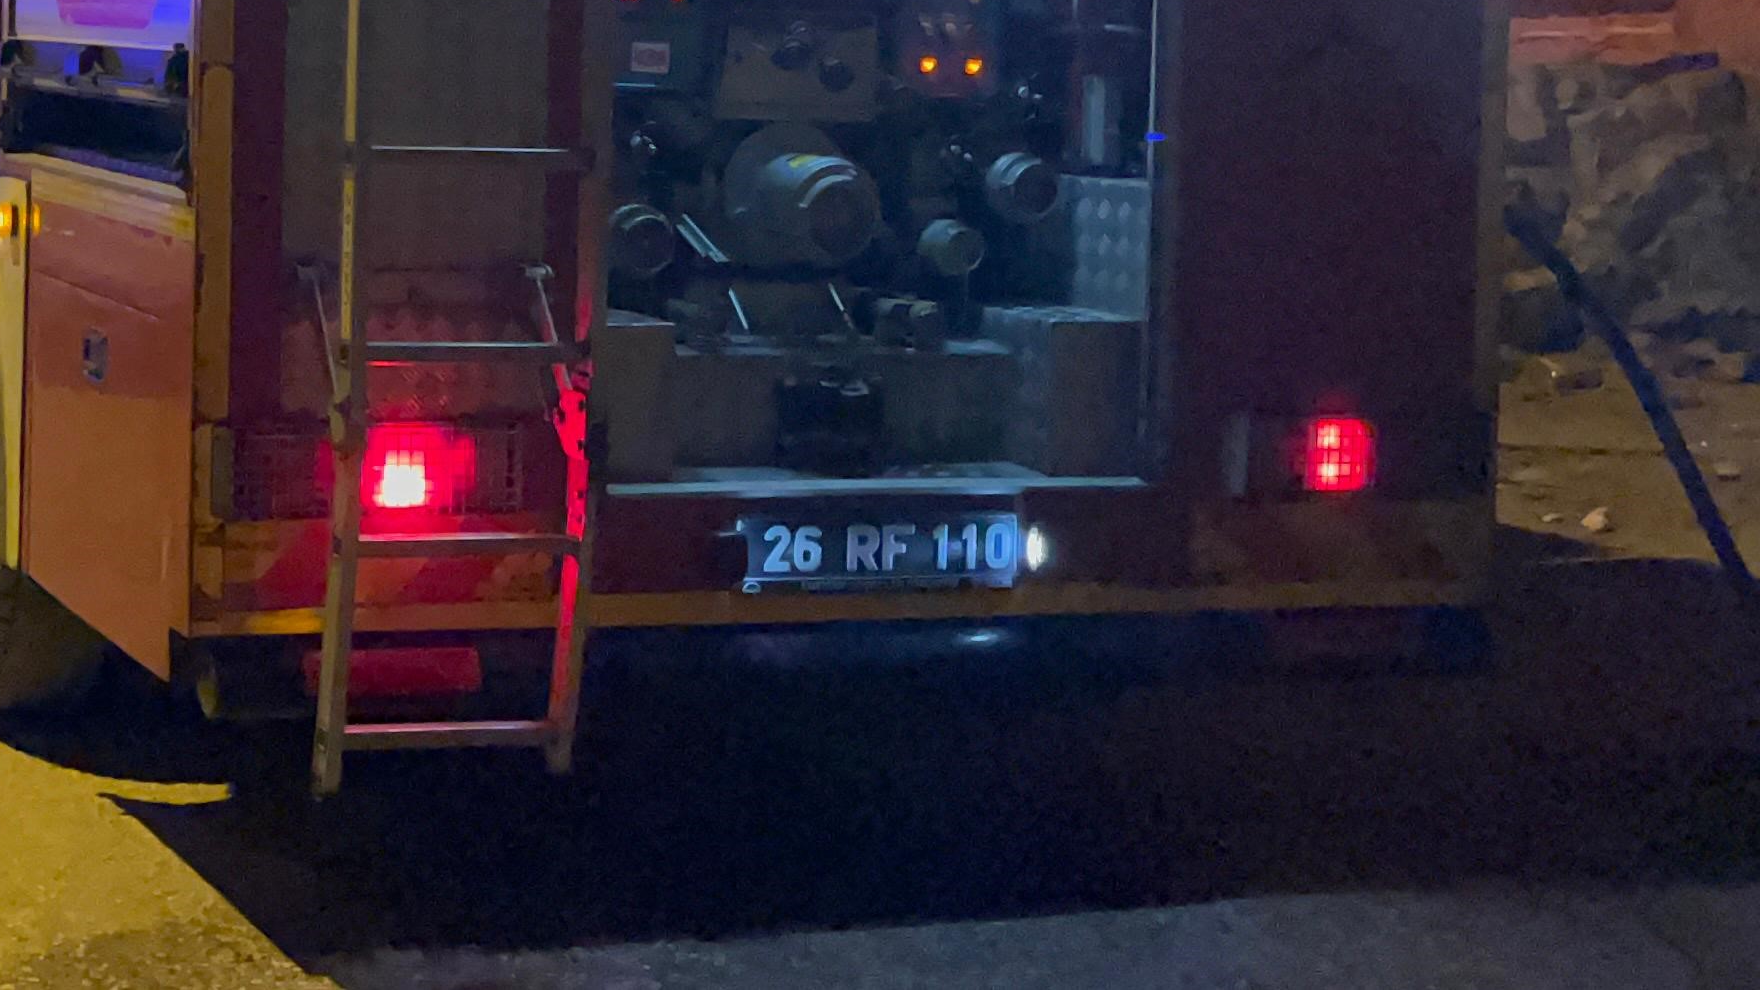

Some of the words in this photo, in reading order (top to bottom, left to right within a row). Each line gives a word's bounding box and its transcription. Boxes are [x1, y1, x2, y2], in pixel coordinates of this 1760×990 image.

[763, 525, 823, 572] 26
[846, 523, 916, 572] RF
[932, 522, 1011, 571] 110
